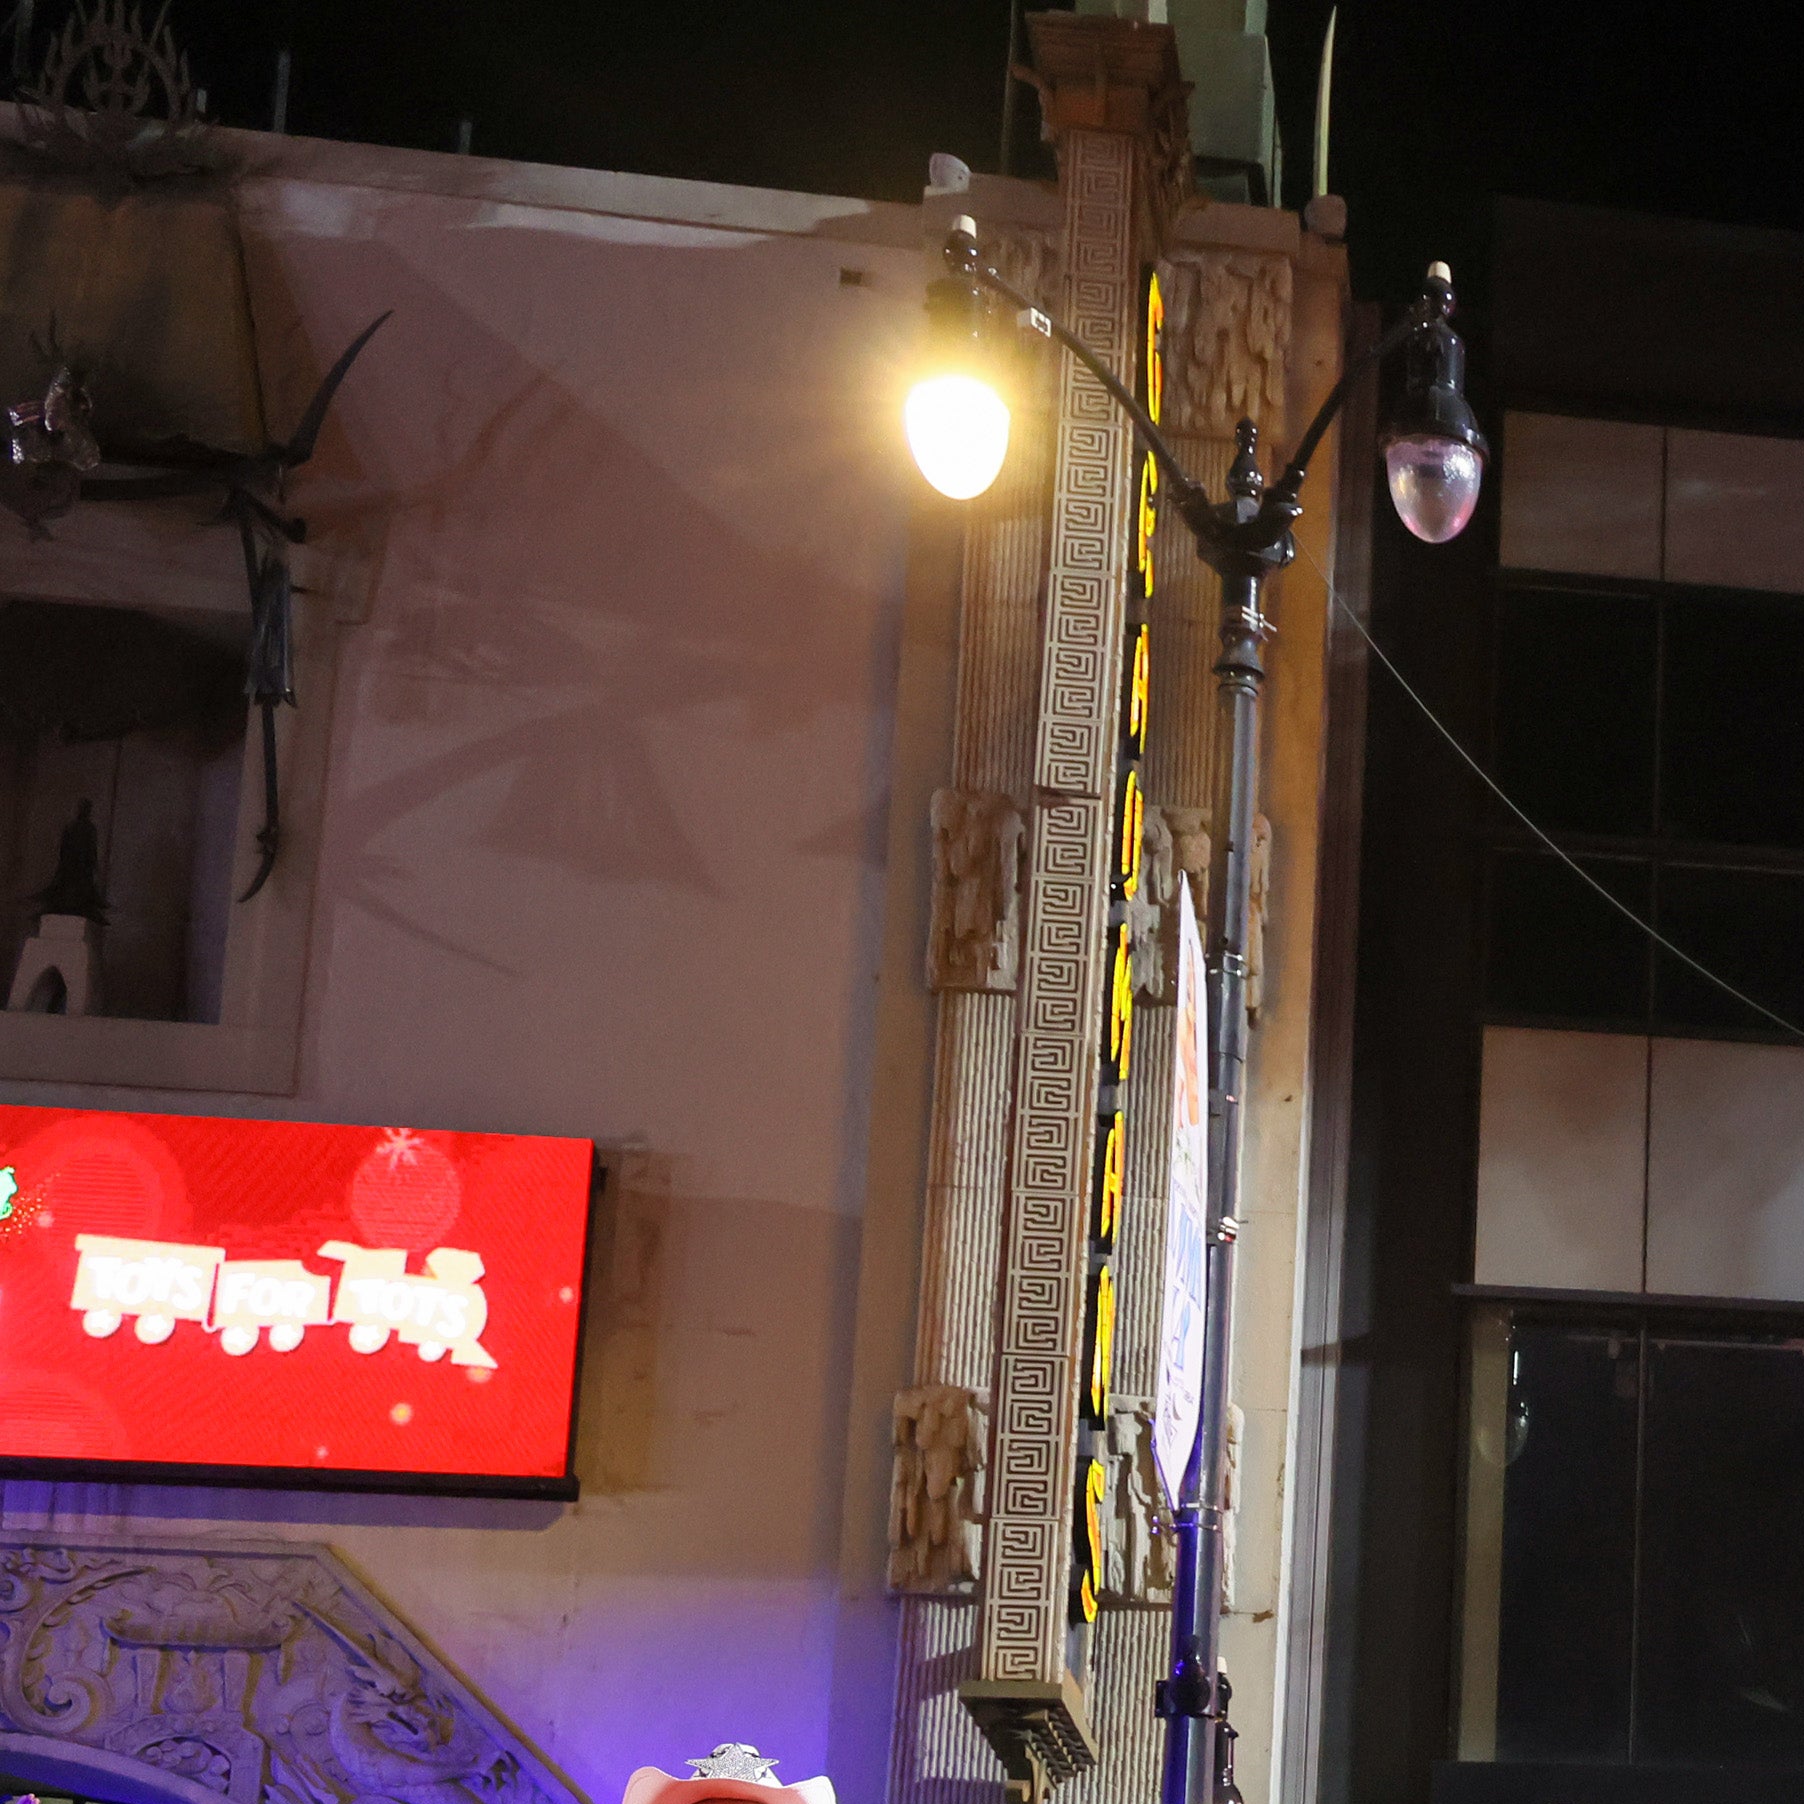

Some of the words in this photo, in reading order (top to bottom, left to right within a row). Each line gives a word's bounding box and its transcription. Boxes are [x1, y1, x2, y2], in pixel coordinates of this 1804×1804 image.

[86, 1255, 203, 1312] TOYS
[220, 1271, 315, 1317] FOR
[347, 1277, 470, 1339] TOTS
